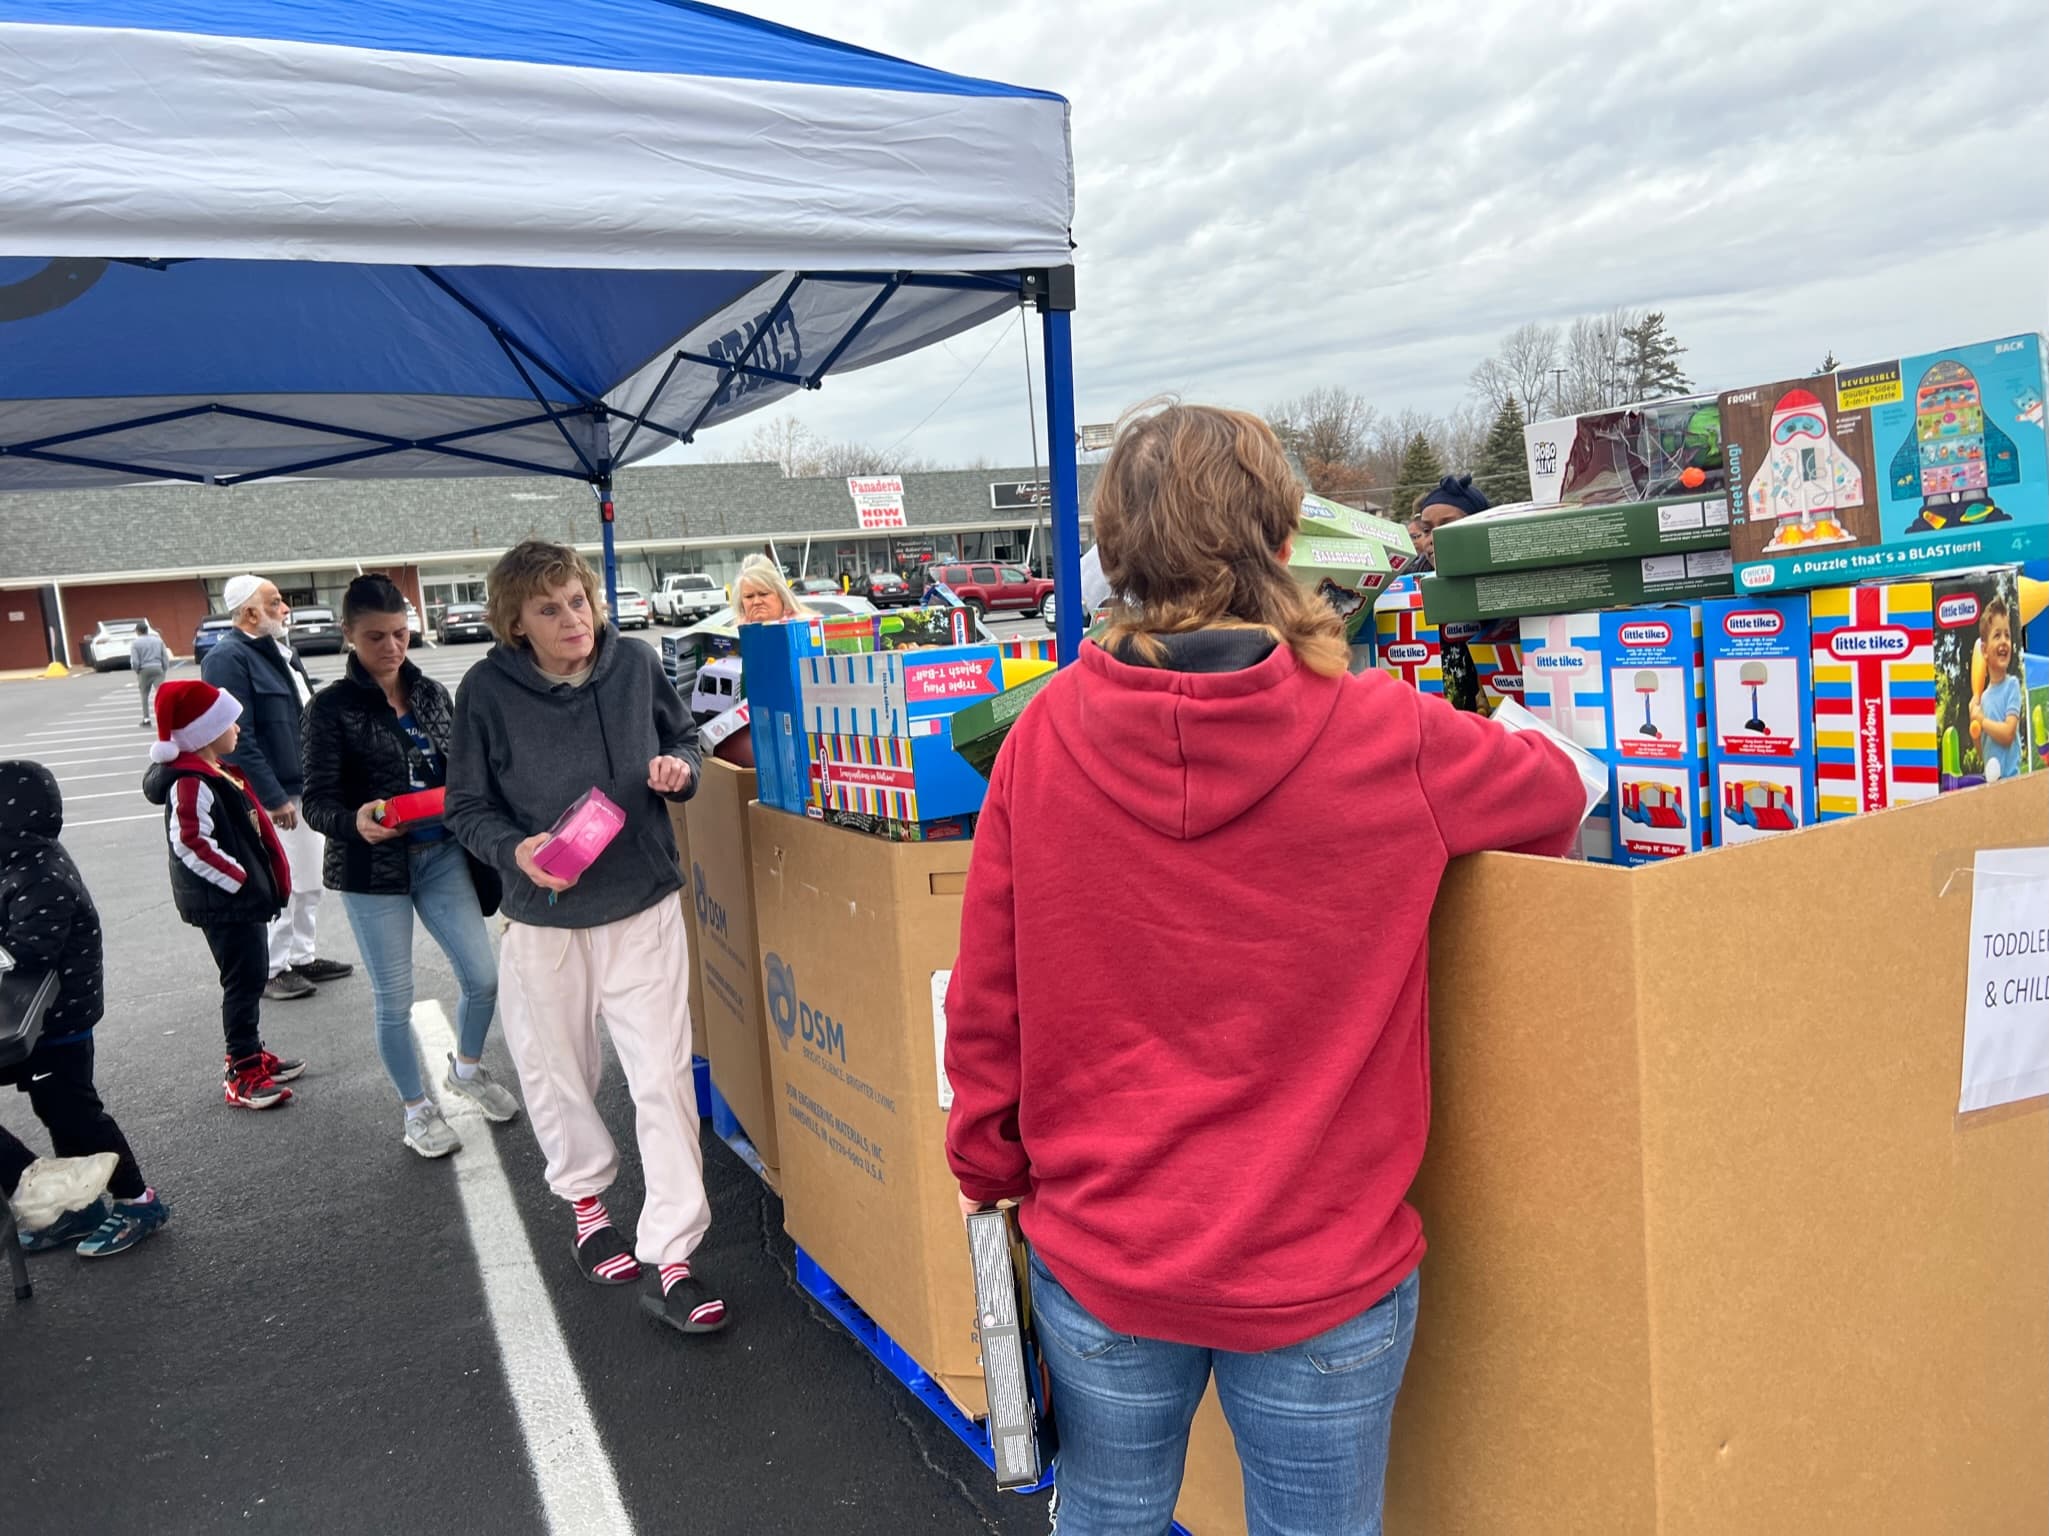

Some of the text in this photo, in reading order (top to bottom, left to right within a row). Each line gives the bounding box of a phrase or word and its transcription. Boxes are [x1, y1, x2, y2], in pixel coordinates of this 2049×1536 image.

[1995, 340, 2025, 354] BACK
[1841, 371, 1896, 388] REVERSIBLE
[1727, 391, 1757, 405] FRONT
[1535, 441, 1557, 460] ROBO
[1536, 459, 1557, 475] ALIVE
[1726, 443, 1745, 526] 3 Feet Long!
[862, 508, 899, 517] NOW
[863, 518, 903, 528] OPEN
[1792, 563, 1802, 575] A
[1804, 557, 1848, 573] Puzzle
[1851, 551, 1894, 568] that's
[1897, 551, 1906, 562] a
[1941, 603, 1975, 618] little tikes
[1446, 622, 1480, 635] little tikes
[1729, 617, 1777, 629] little tikes
[1624, 629, 1666, 640] little tikes
[1835, 636, 1904, 651] little tikes
[1389, 647, 1425, 658] little tikes
[1537, 654, 1583, 667] little tikes
[948, 662, 983, 678] Splash
[923, 678, 977, 693] Triple Play
[1494, 677, 1514, 688] little
[1861, 697, 1884, 801] Imaginations
[1633, 843, 1652, 853] Jump
[708, 895, 728, 939] DSM
[1983, 929, 2049, 959] TODDLE
[1985, 980, 1997, 1008] &
[800, 1000, 846, 1064] DSM
[846, 1072, 874, 1099] BRIGHTER
[798, 1090, 835, 1128] ENGINEERING
